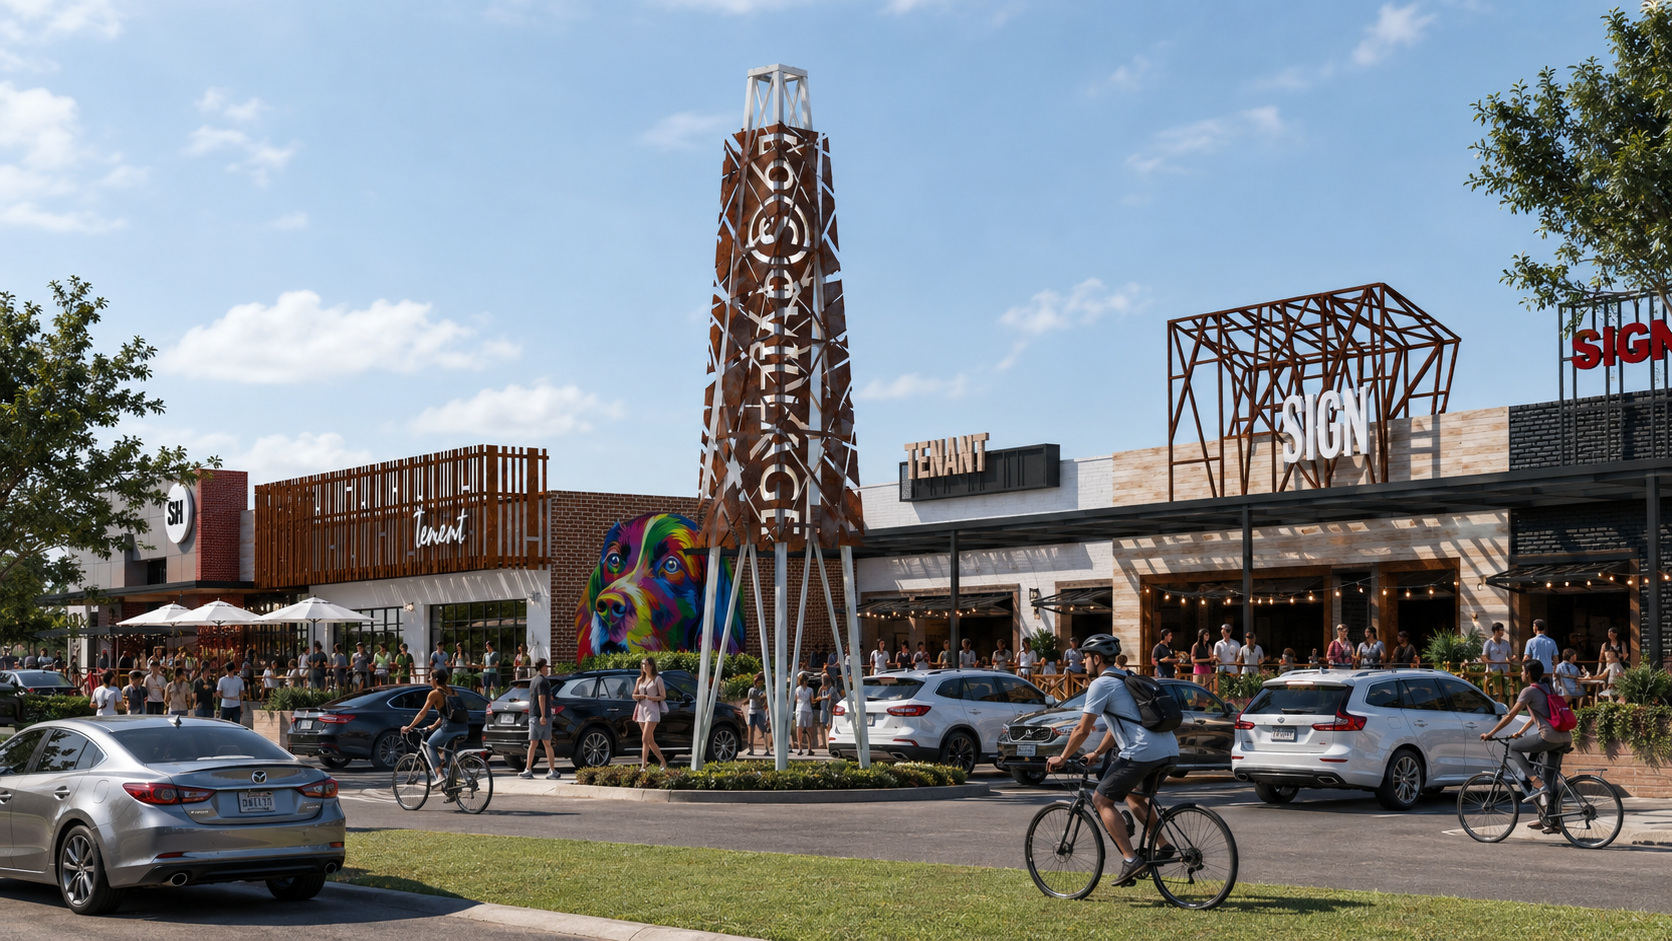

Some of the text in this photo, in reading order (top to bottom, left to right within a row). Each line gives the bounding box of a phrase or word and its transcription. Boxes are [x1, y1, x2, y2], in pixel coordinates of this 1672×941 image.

[1571, 319, 1672, 369] SIGN
[1282, 386, 1369, 463] SIGN
[904, 433, 989, 479] TENANT
[168, 500, 183, 525] SH
